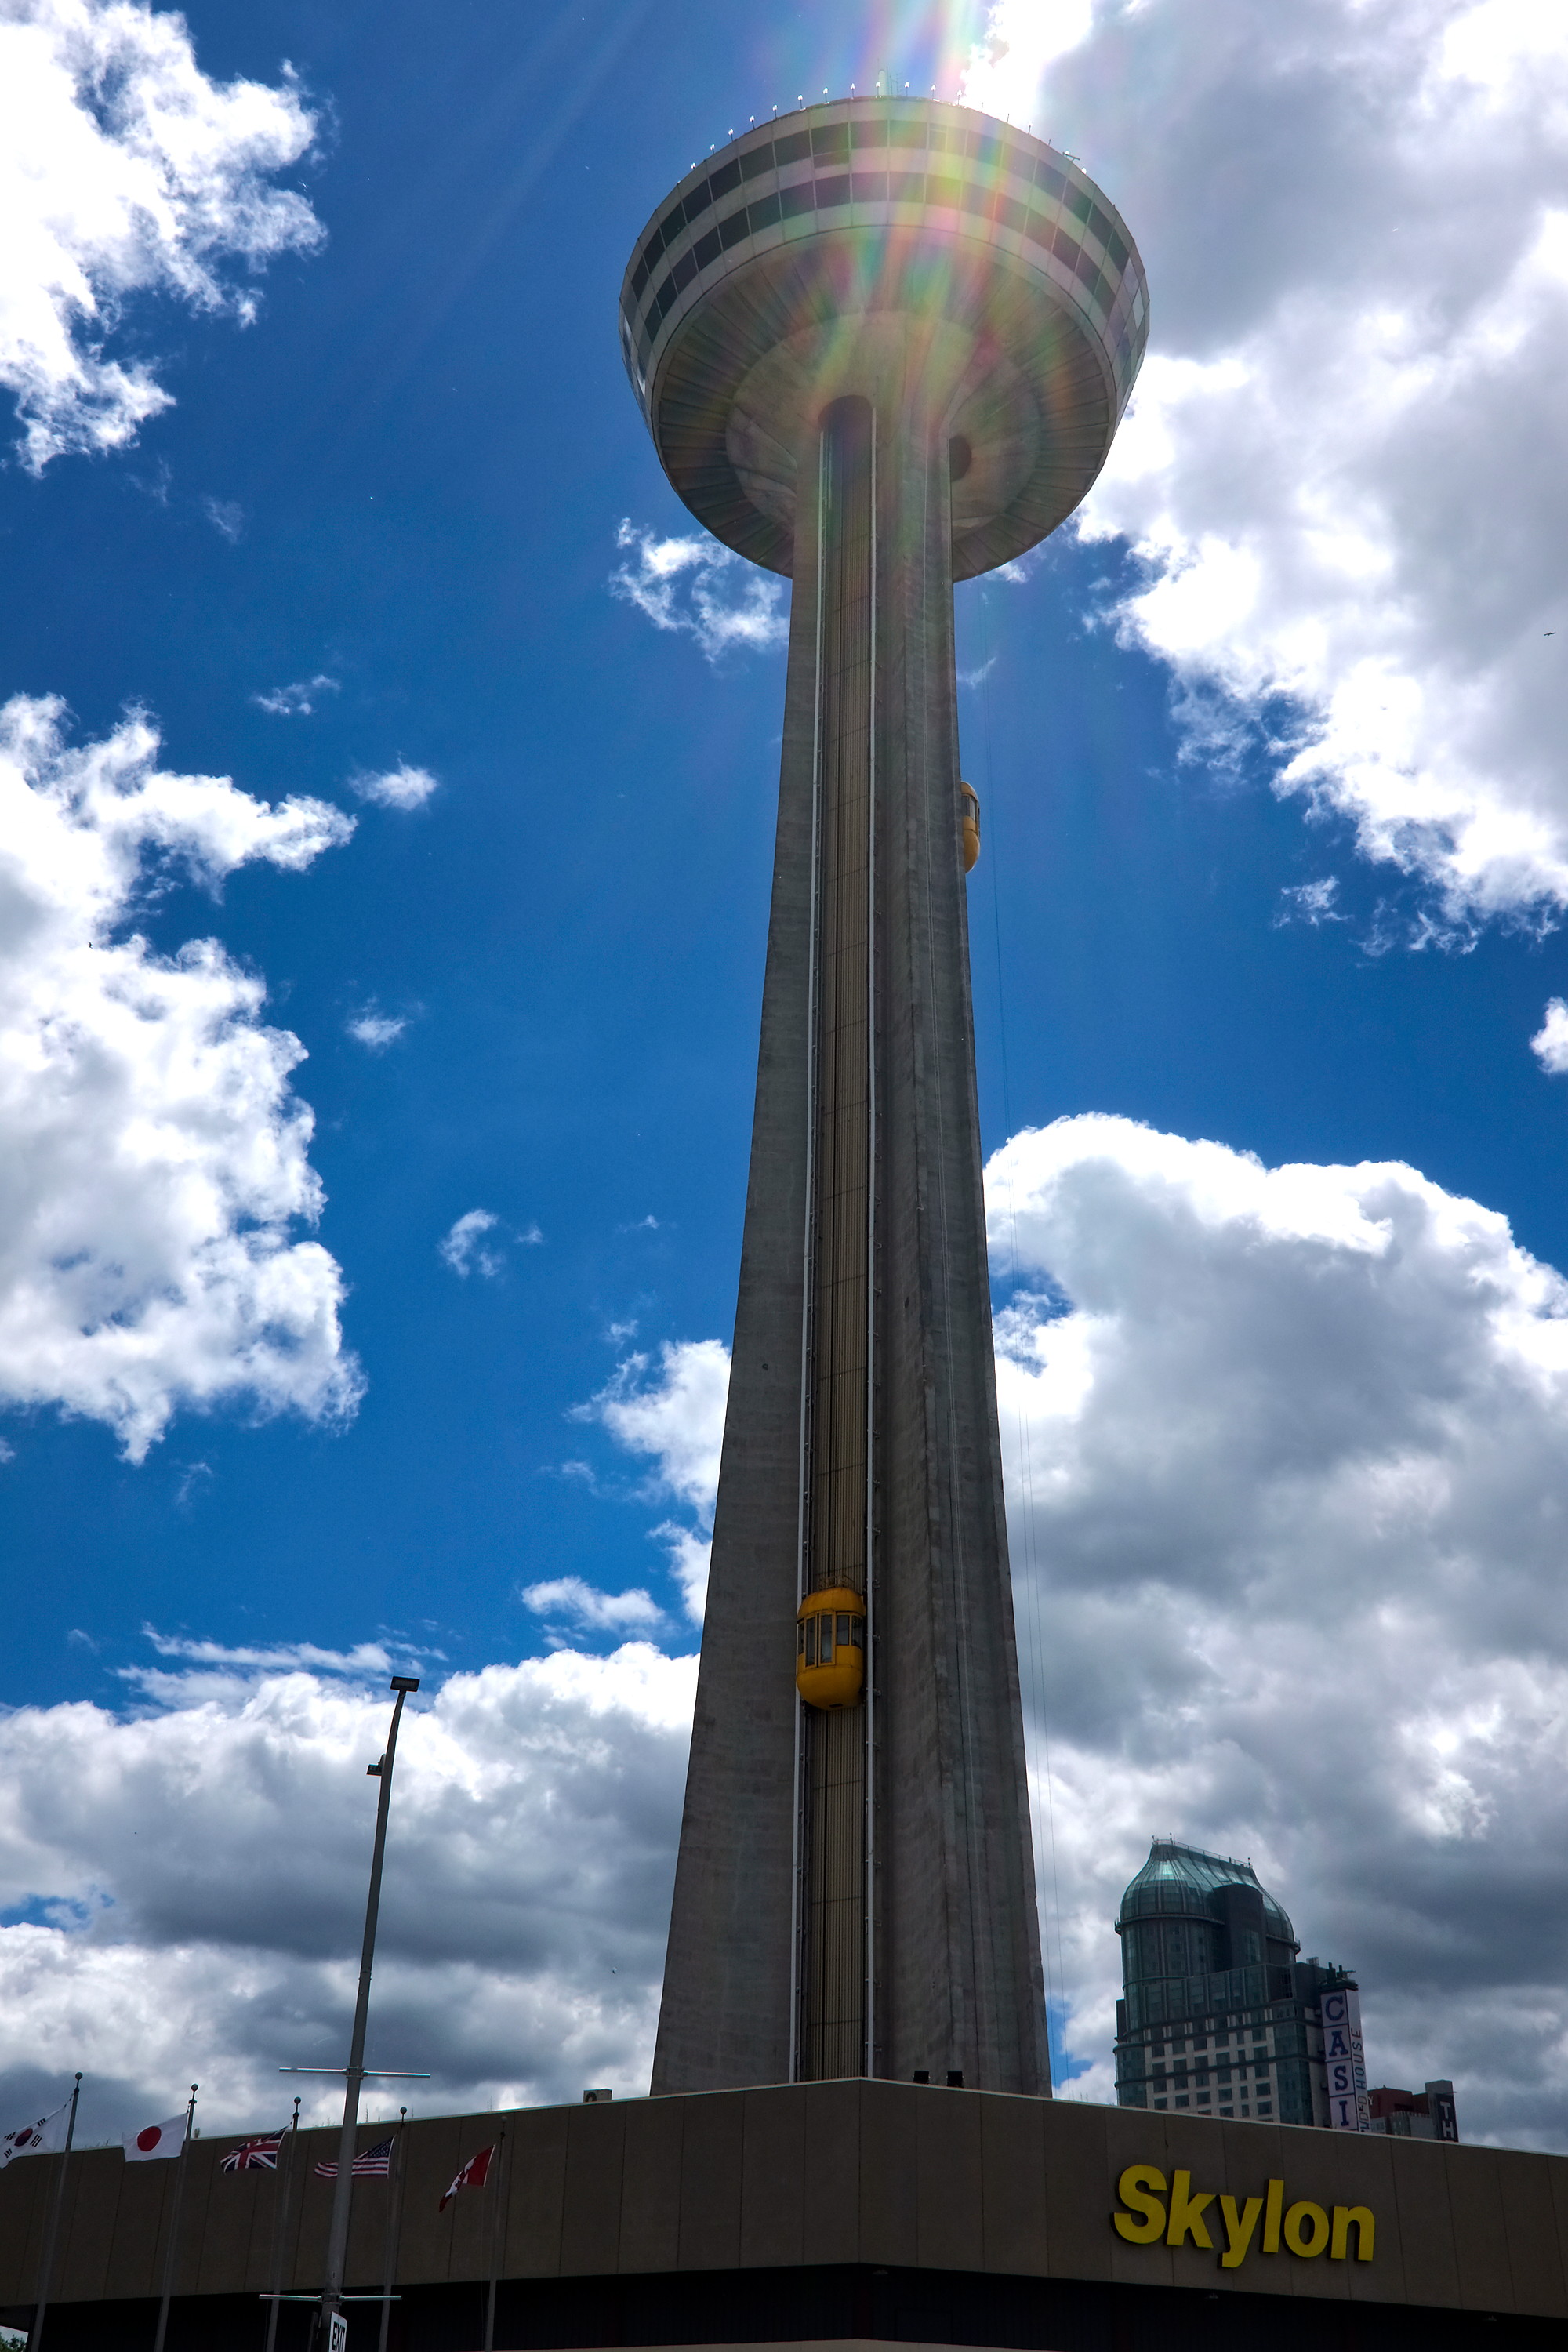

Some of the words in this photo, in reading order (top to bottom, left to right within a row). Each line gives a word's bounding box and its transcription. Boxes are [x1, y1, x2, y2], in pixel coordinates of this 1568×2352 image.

[1350, 2027, 1367, 2089] HOUSE
[1439, 2101, 1454, 2139] TH
[1114, 2165, 1375, 2268] Skylon
[332, 2321, 346, 2352] EXIT
